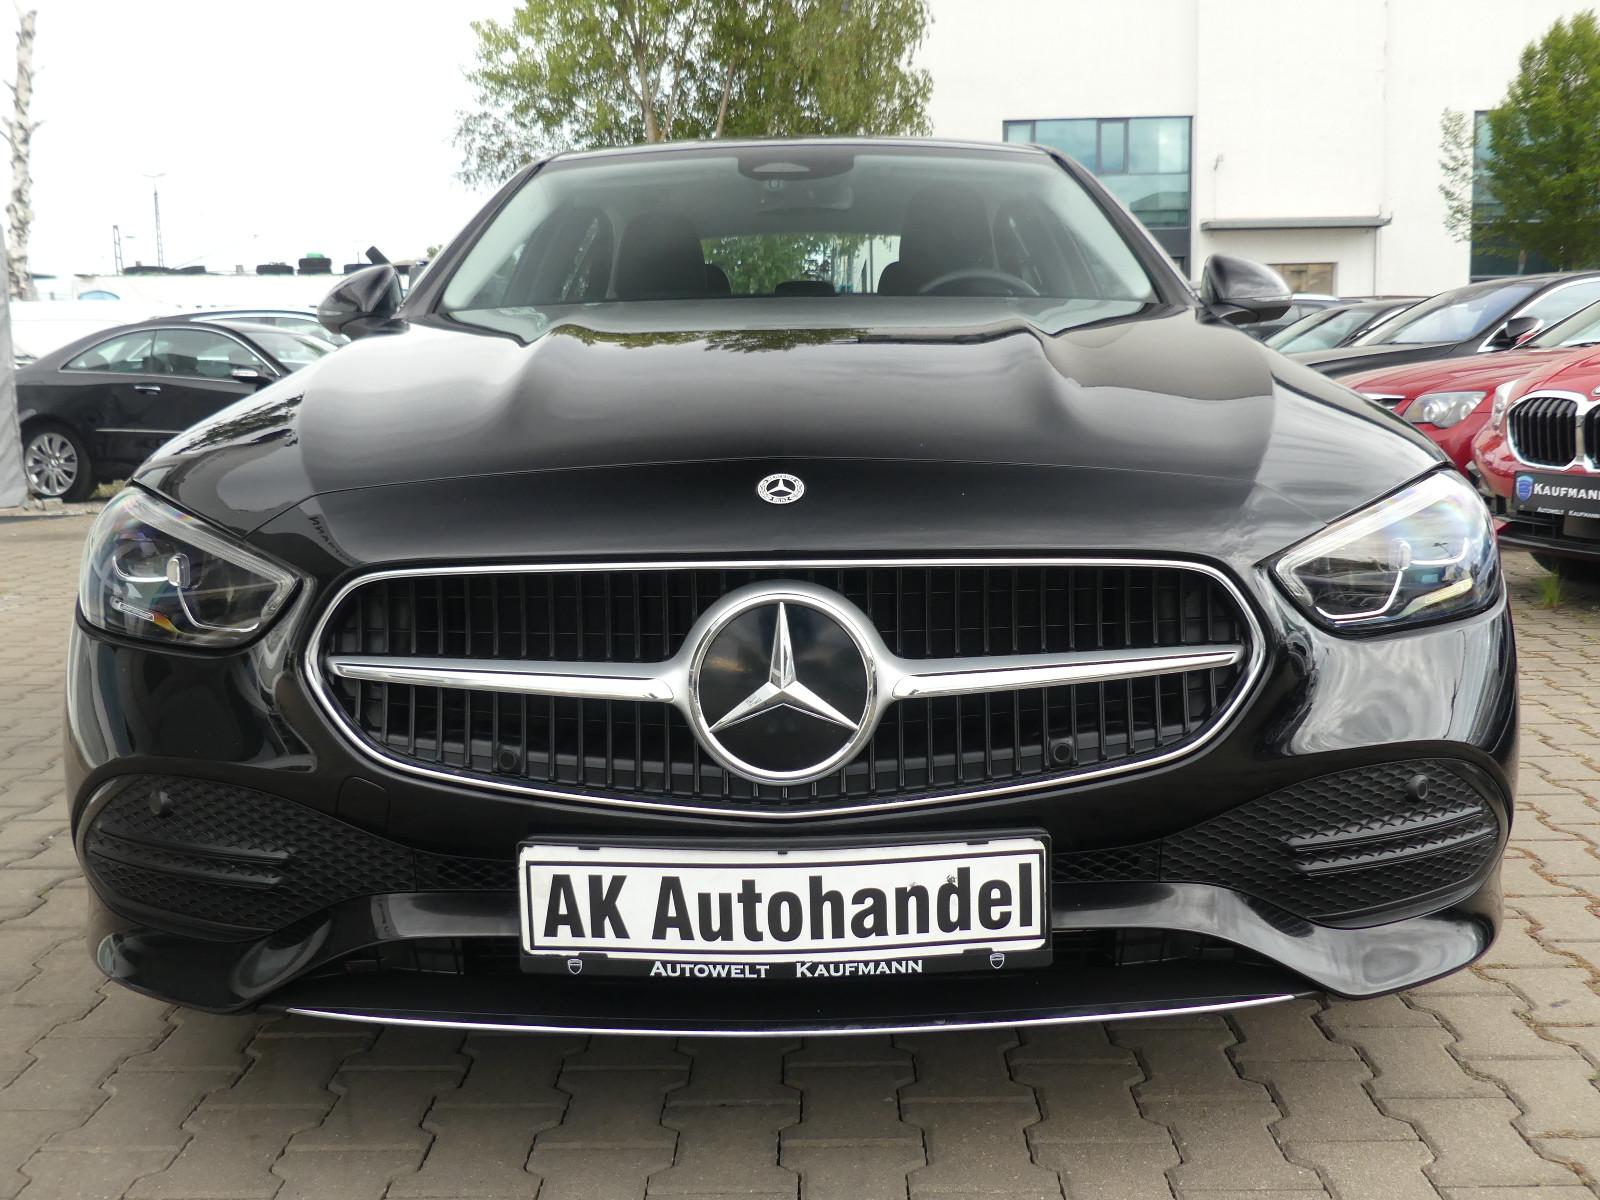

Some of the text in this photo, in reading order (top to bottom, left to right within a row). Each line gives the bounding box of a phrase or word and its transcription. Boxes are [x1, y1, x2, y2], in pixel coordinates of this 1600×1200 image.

[543, 862, 1033, 942] AK Autohandel
[649, 959, 924, 978] AUTOWELT KAUFMANN
